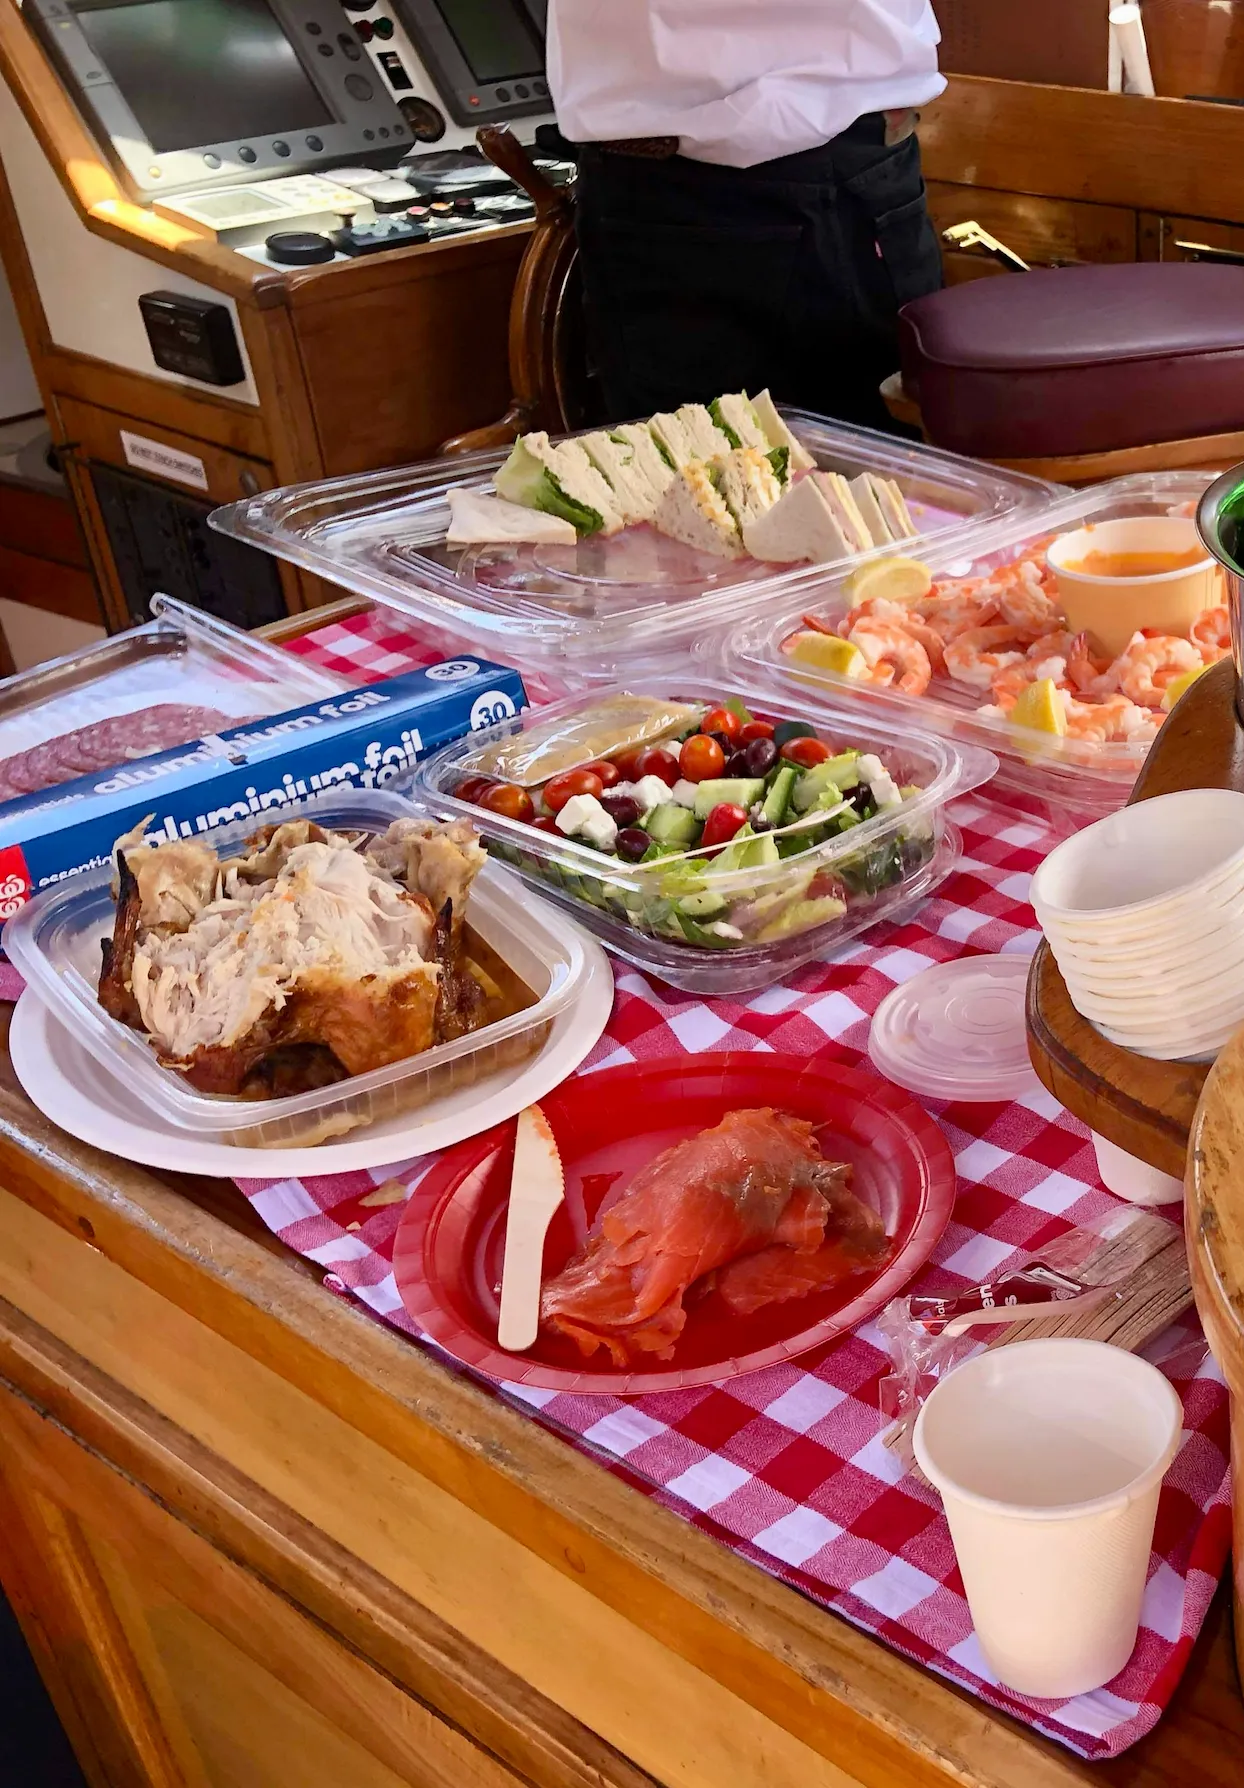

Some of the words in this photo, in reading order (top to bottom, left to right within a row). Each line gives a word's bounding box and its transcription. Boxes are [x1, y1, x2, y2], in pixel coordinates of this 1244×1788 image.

[433, 664, 468, 677] 30
[319, 691, 391, 719] foil
[478, 701, 508, 728] 30
[363, 729, 424, 774] foil
